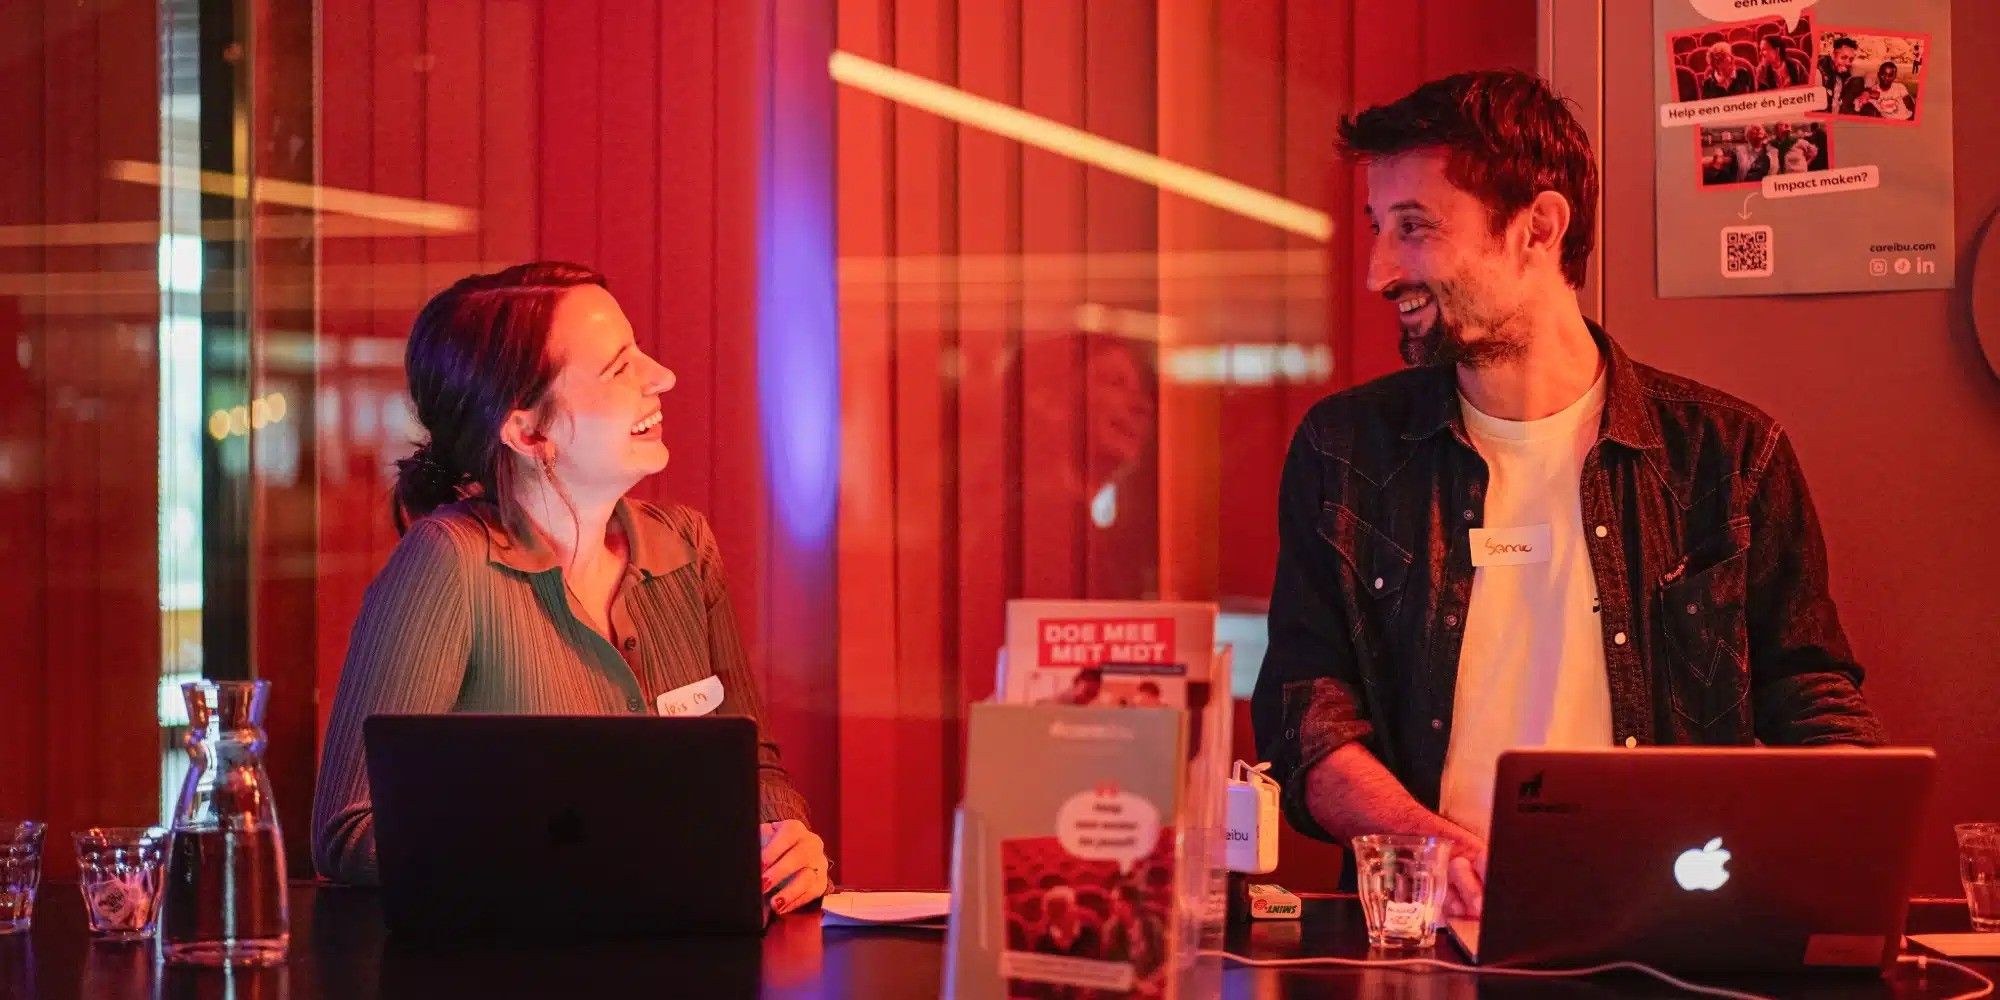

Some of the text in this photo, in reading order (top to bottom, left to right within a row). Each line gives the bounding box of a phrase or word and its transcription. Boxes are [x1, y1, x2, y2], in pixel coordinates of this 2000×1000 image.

[1669, 108, 1695, 119] Help
[1698, 105, 1720, 115] een
[1723, 101, 1757, 112] ander
[1760, 98, 1776, 108] én
[1774, 172, 1868, 192] Impact maken?
[1870, 242, 1936, 252] careibu.com
[1045, 622, 1157, 643] DOE MEE
[1051, 643, 1104, 662] MET
[1225, 829, 1249, 841] eibu
